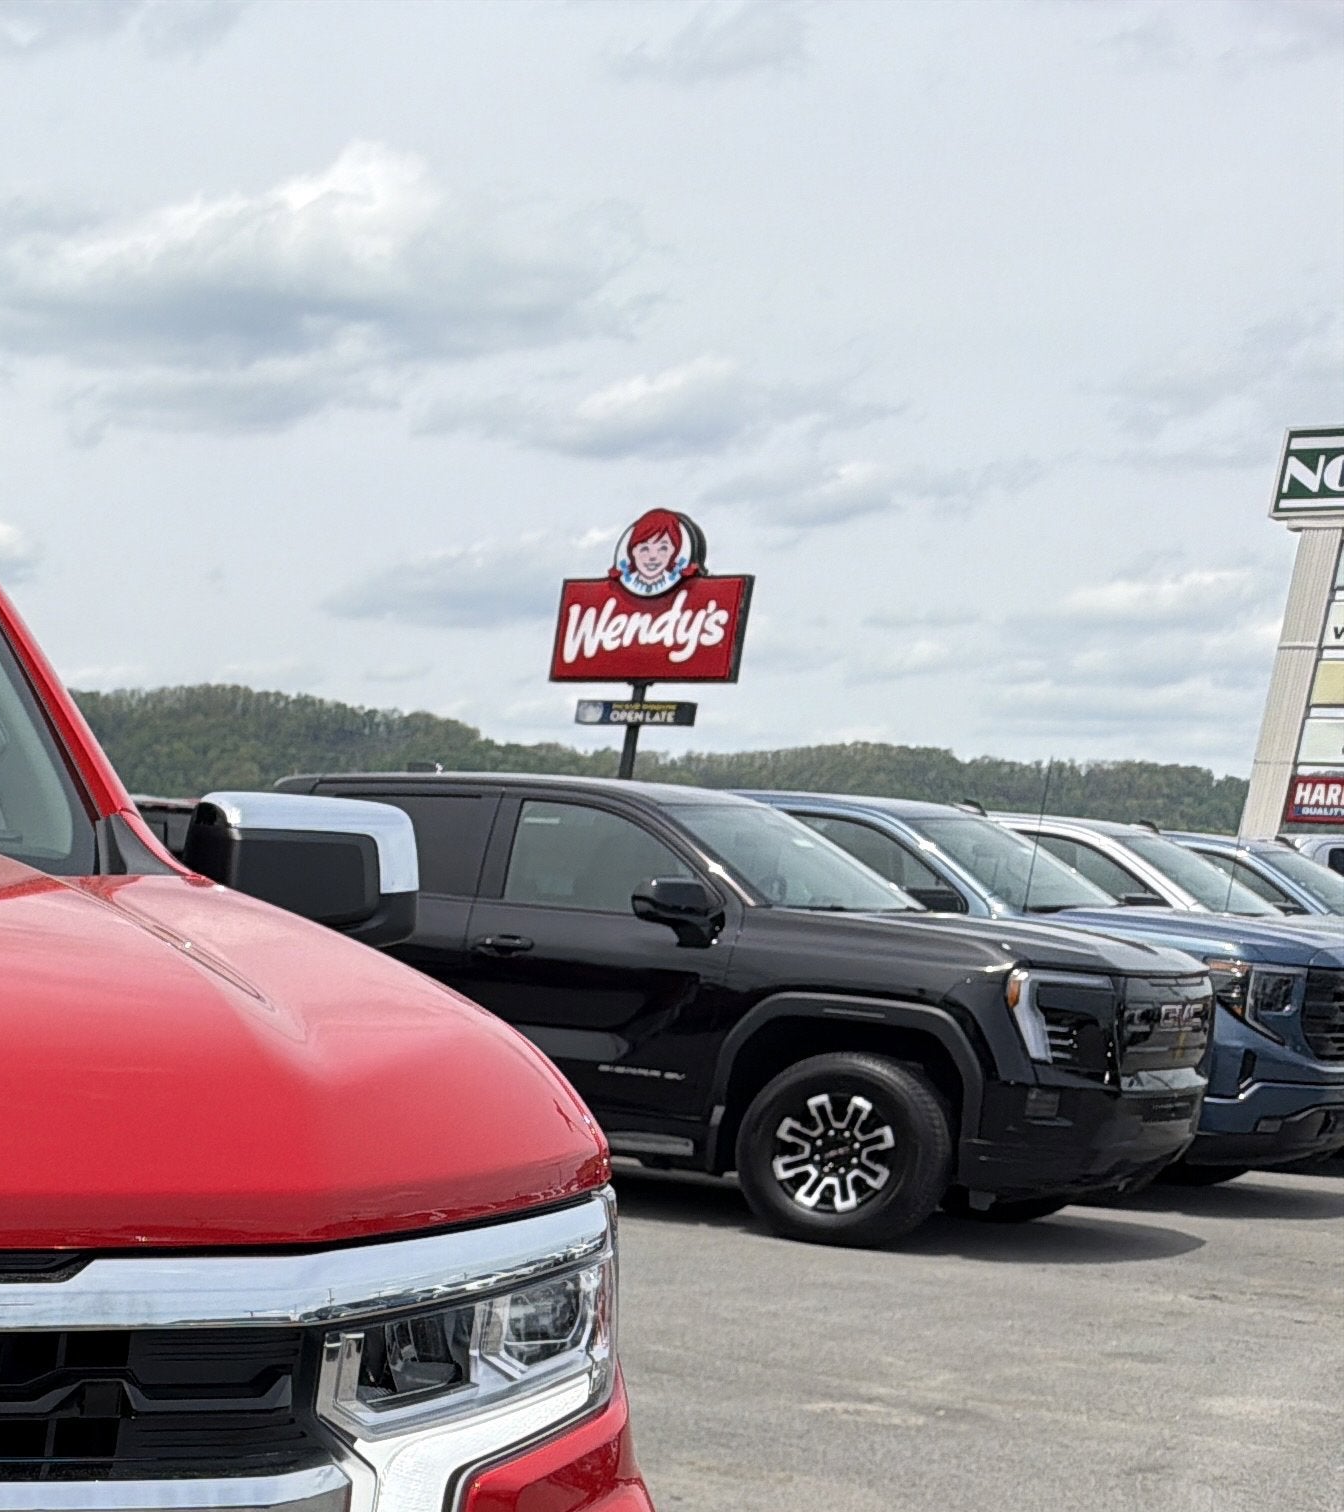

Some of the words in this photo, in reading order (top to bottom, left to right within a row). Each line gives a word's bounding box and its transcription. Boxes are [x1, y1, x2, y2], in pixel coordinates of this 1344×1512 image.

[563, 589, 729, 663] Wendy's
[610, 710, 644, 722] OPEN
[645, 711, 676, 723] LATE
[1294, 782, 1344, 806] HAR
